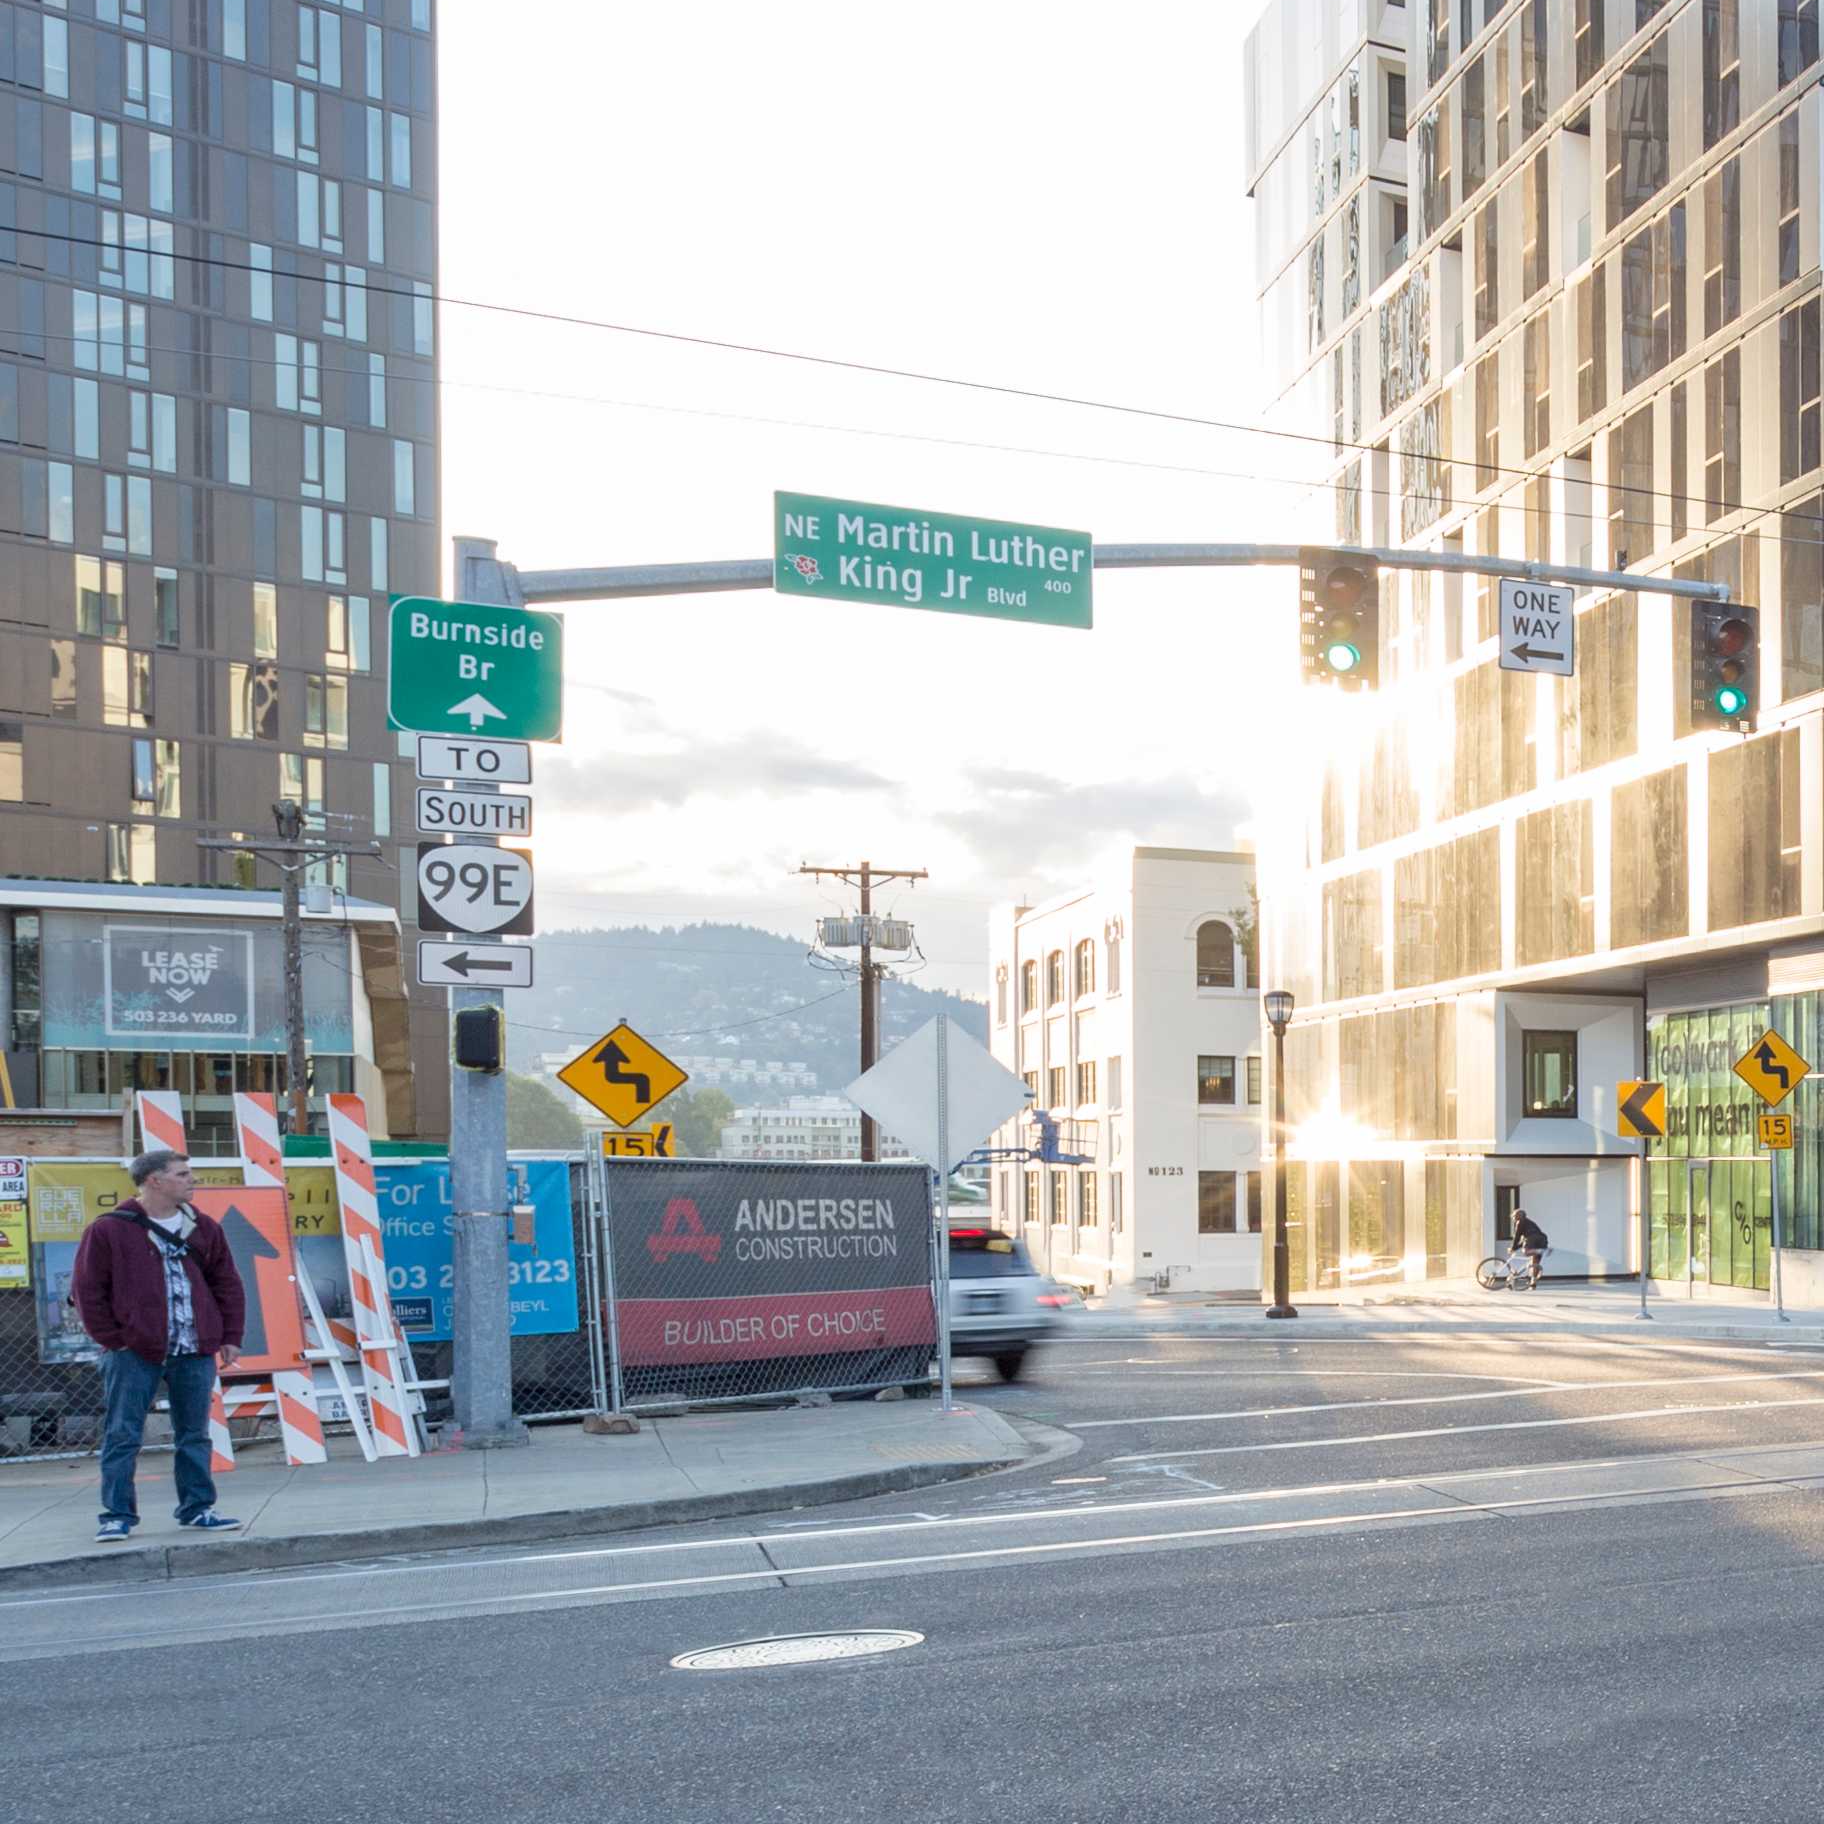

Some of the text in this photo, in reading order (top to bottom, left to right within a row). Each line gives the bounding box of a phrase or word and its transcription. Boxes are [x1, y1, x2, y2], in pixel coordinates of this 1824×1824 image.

[785, 513, 1085, 573] NE Martin Luther
[840, 555, 1026, 607] King Jr Blvd
[1044, 580, 1071, 594] 400
[1513, 590, 1561, 614] ONE
[410, 612, 544, 651] Burnside
[1512, 615, 1561, 639] WAY
[459, 654, 495, 681] Br
[447, 747, 500, 773] TO
[425, 796, 525, 830] SOUTH
[425, 860, 520, 907] 99E
[141, 950, 219, 969] LEASE
[149, 967, 212, 985] NOW
[124, 1010, 237, 1025] 503 236 YARD
[1695, 1102, 1750, 1137] mean
[1764, 1119, 1786, 1136] 15
[608, 1138, 645, 1156] 15
[2, 1181, 24, 1192] AREA
[735, 1199, 895, 1232] ANDERSEN
[736, 1234, 897, 1261] CONSTRUCTION
[664, 1309, 886, 1345] BUILDER OF CHOICE
